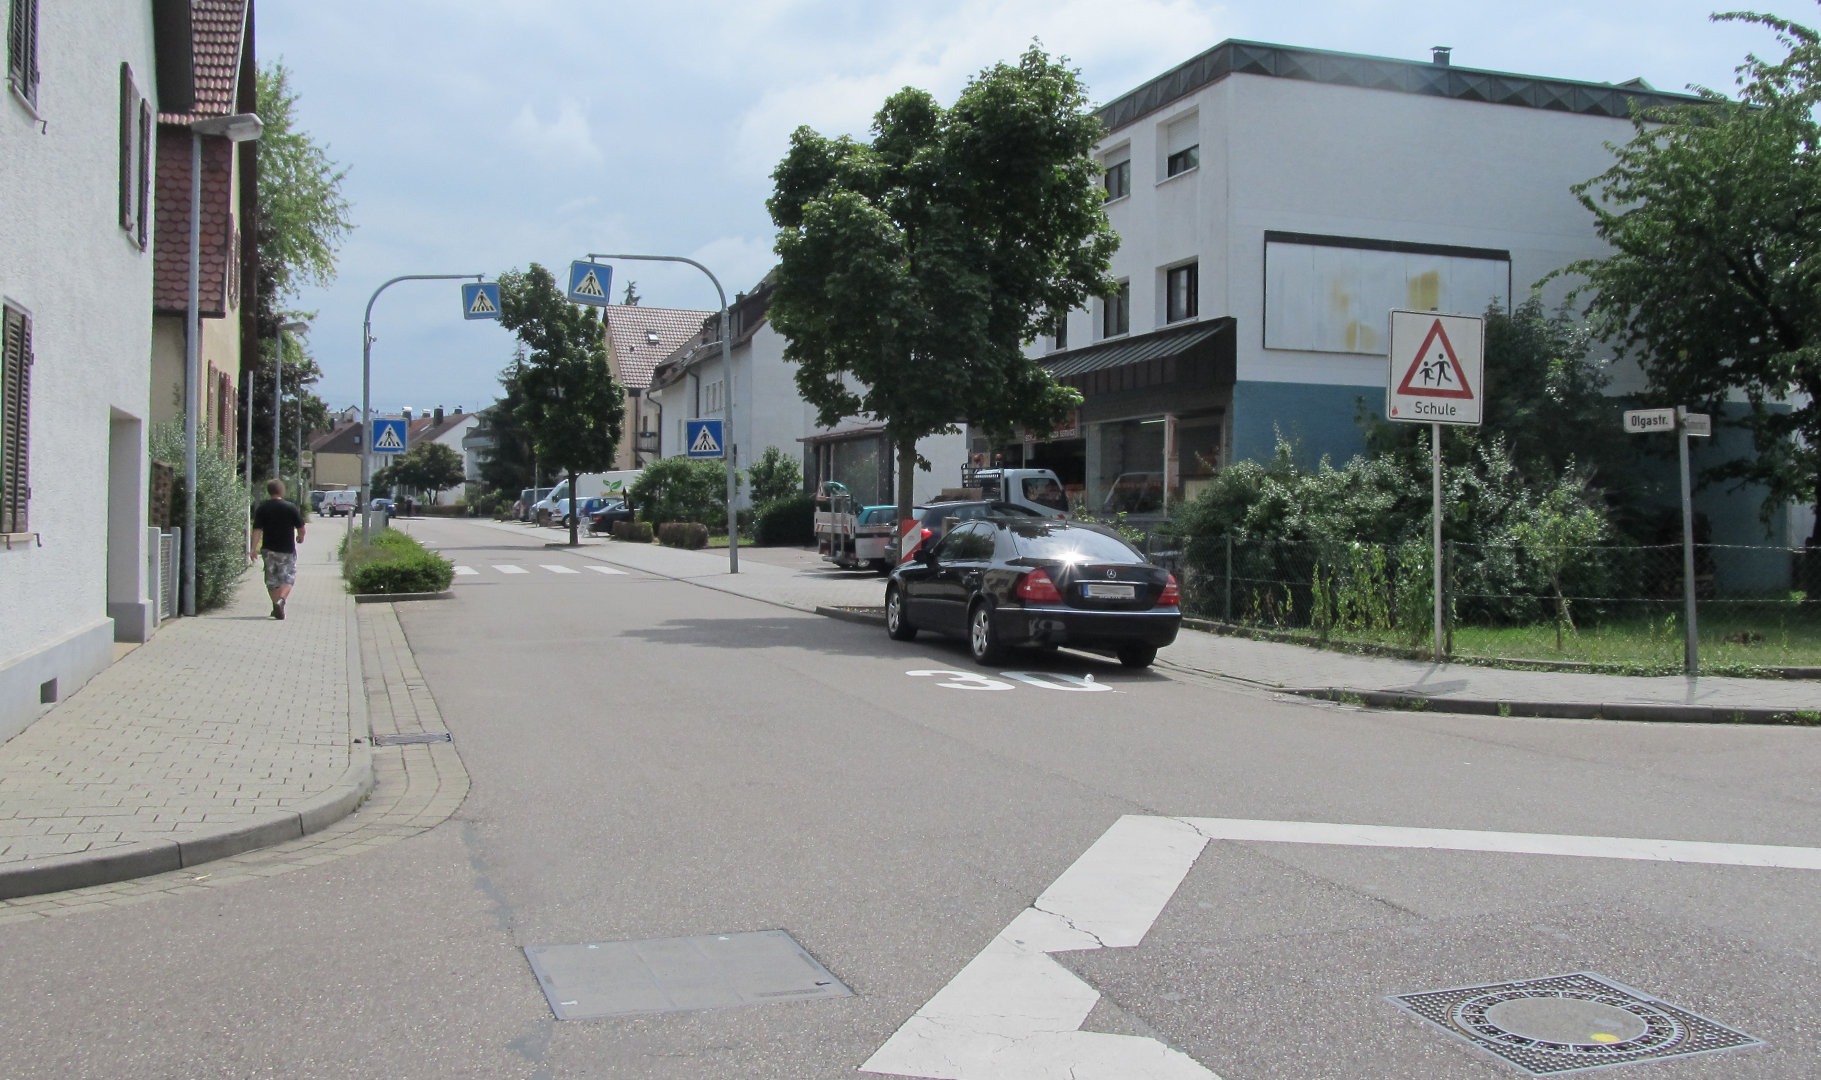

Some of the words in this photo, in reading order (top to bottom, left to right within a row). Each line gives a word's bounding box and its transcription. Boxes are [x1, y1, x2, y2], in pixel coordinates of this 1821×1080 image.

[1415, 401, 1457, 416] Schule
[1631, 414, 1669, 429] Olgastr.
[905, 669, 1114, 692] 30
